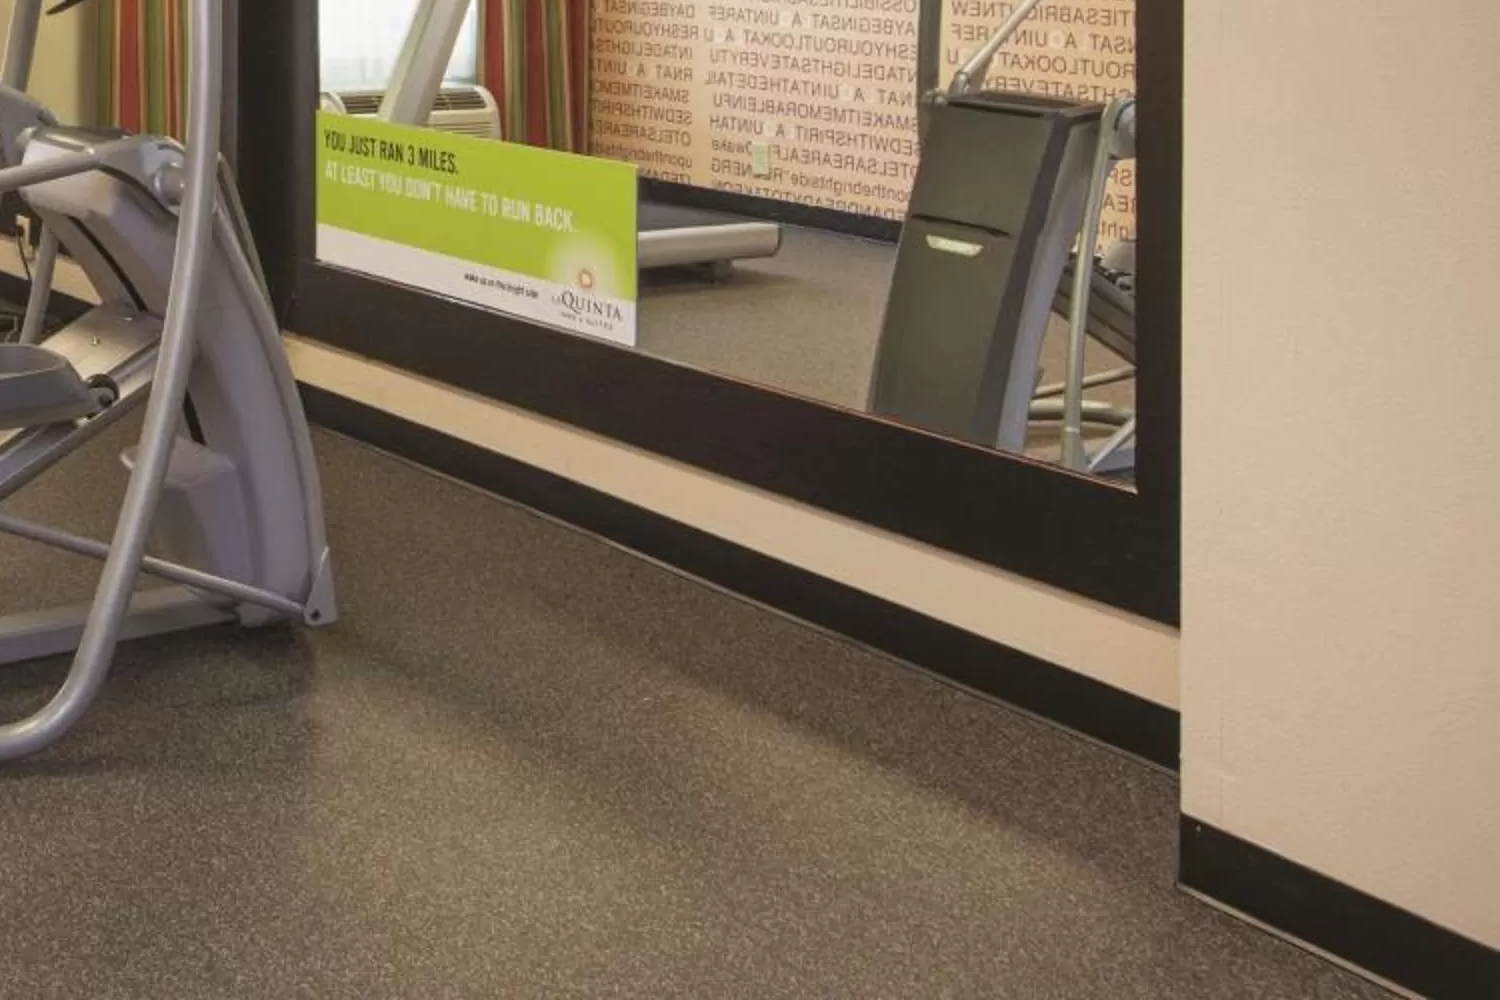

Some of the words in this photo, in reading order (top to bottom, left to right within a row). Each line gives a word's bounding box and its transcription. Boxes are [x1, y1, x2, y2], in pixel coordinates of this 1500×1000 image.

[324, 129, 344, 152] YOU
[348, 136, 377, 158] JUST
[380, 141, 403, 163] RAN
[407, 146, 415, 165] 3
[418, 148, 458, 174] MILES.
[325, 160, 338, 180] AT
[341, 164, 376, 189] LEAST
[379, 172, 400, 195] YOU
[405, 177, 441, 201] DON'T
[445, 186, 477, 210] HAVE
[481, 192, 497, 215] TO
[502, 197, 530, 222] RUN
[534, 204, 578, 232] BACK.
